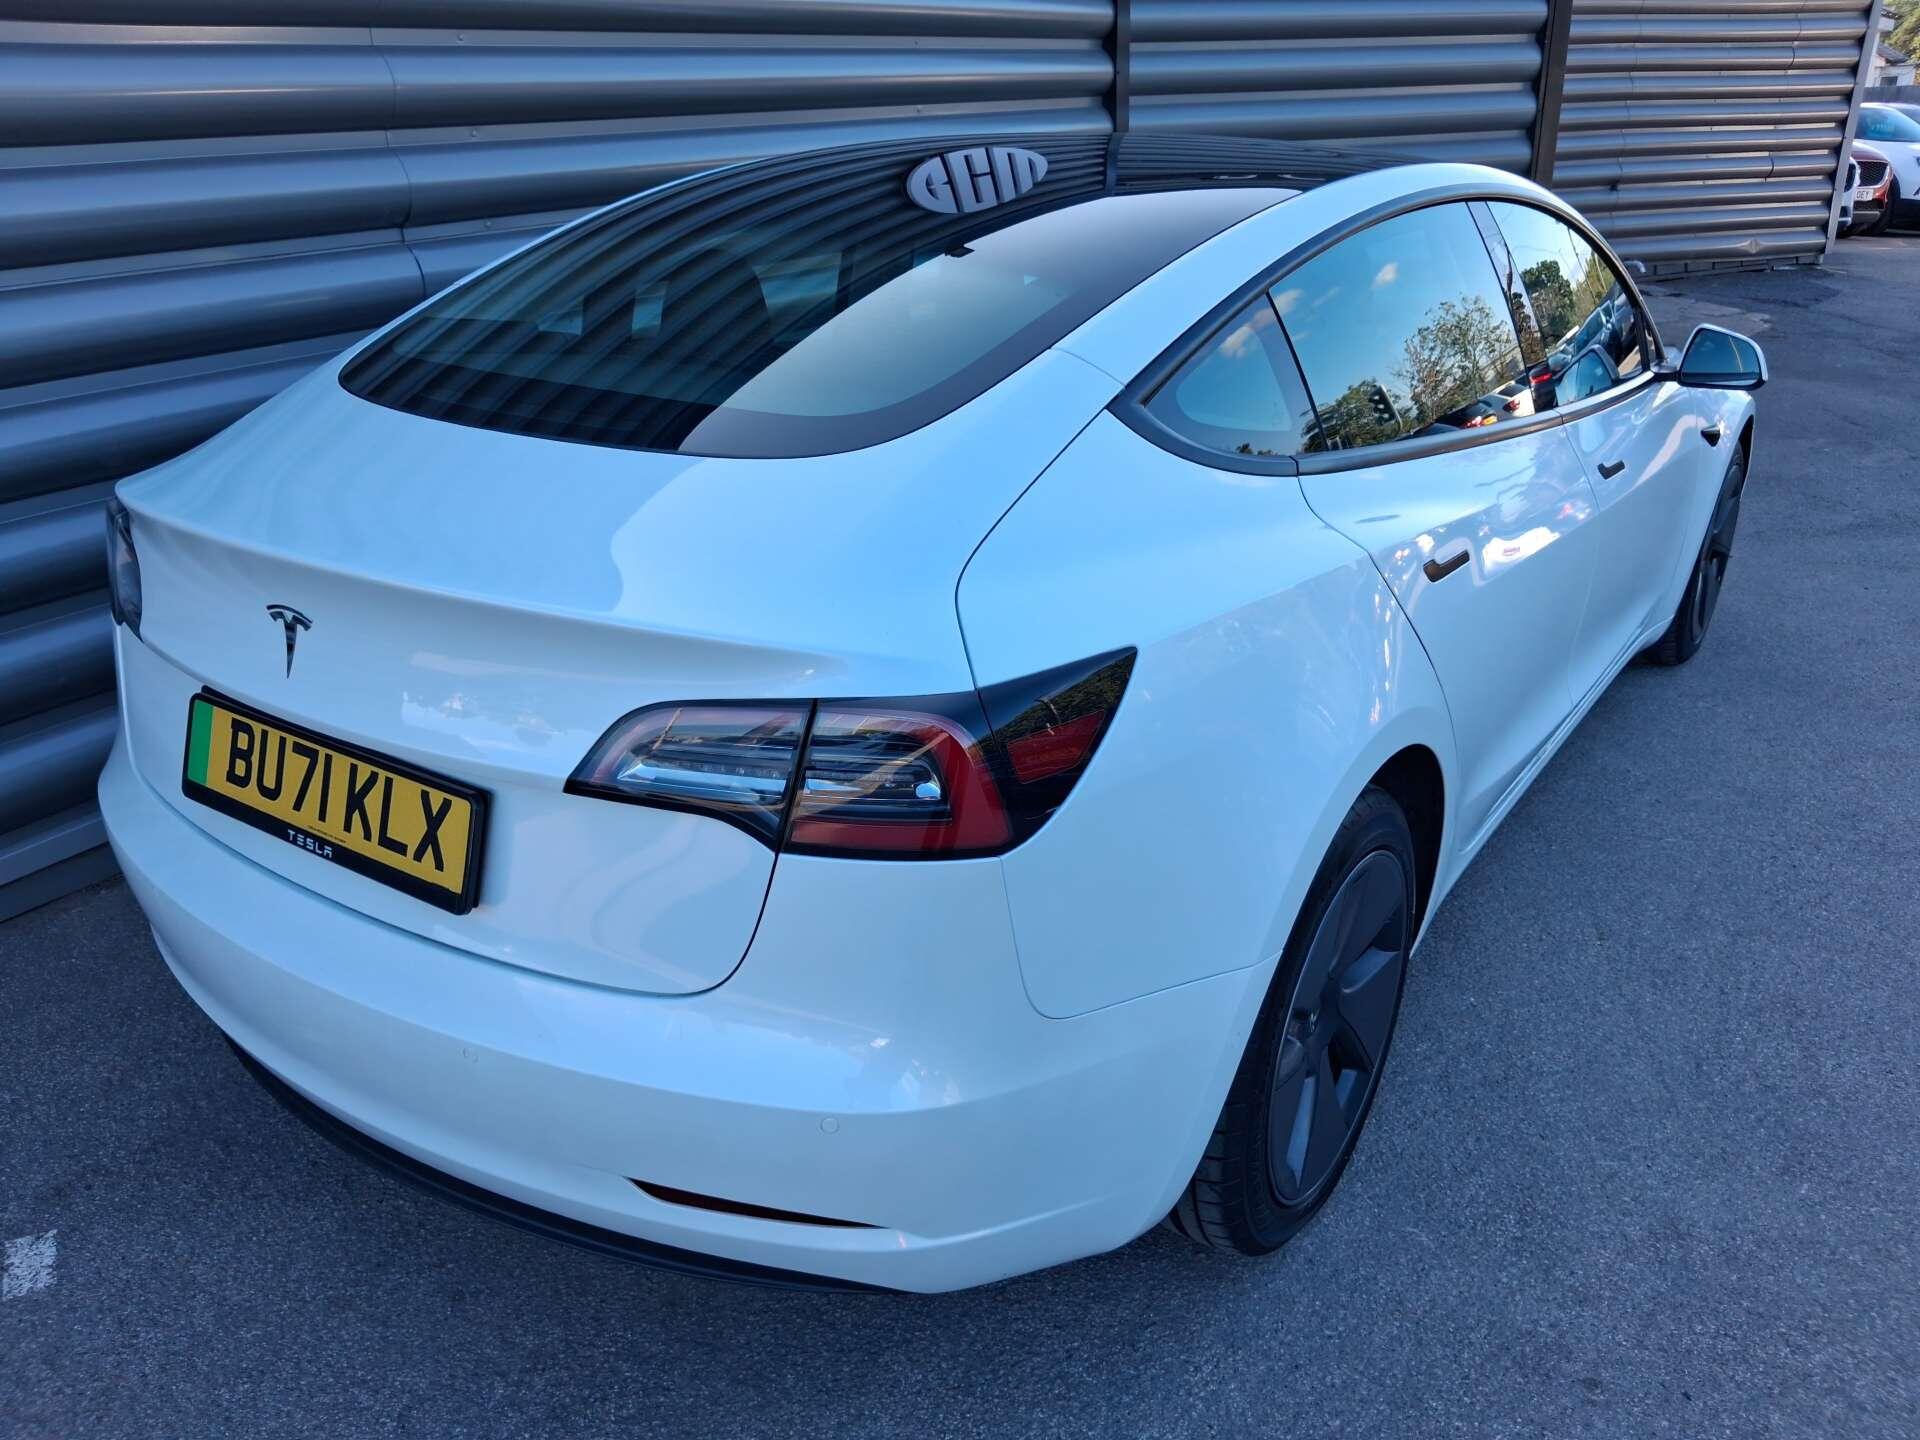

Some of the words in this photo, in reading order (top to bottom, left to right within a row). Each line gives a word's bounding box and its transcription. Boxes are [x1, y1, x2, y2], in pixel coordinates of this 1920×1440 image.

[226, 716, 333, 823] BU71
[343, 763, 452, 872] KLX
[287, 829, 333, 859] TESLA
